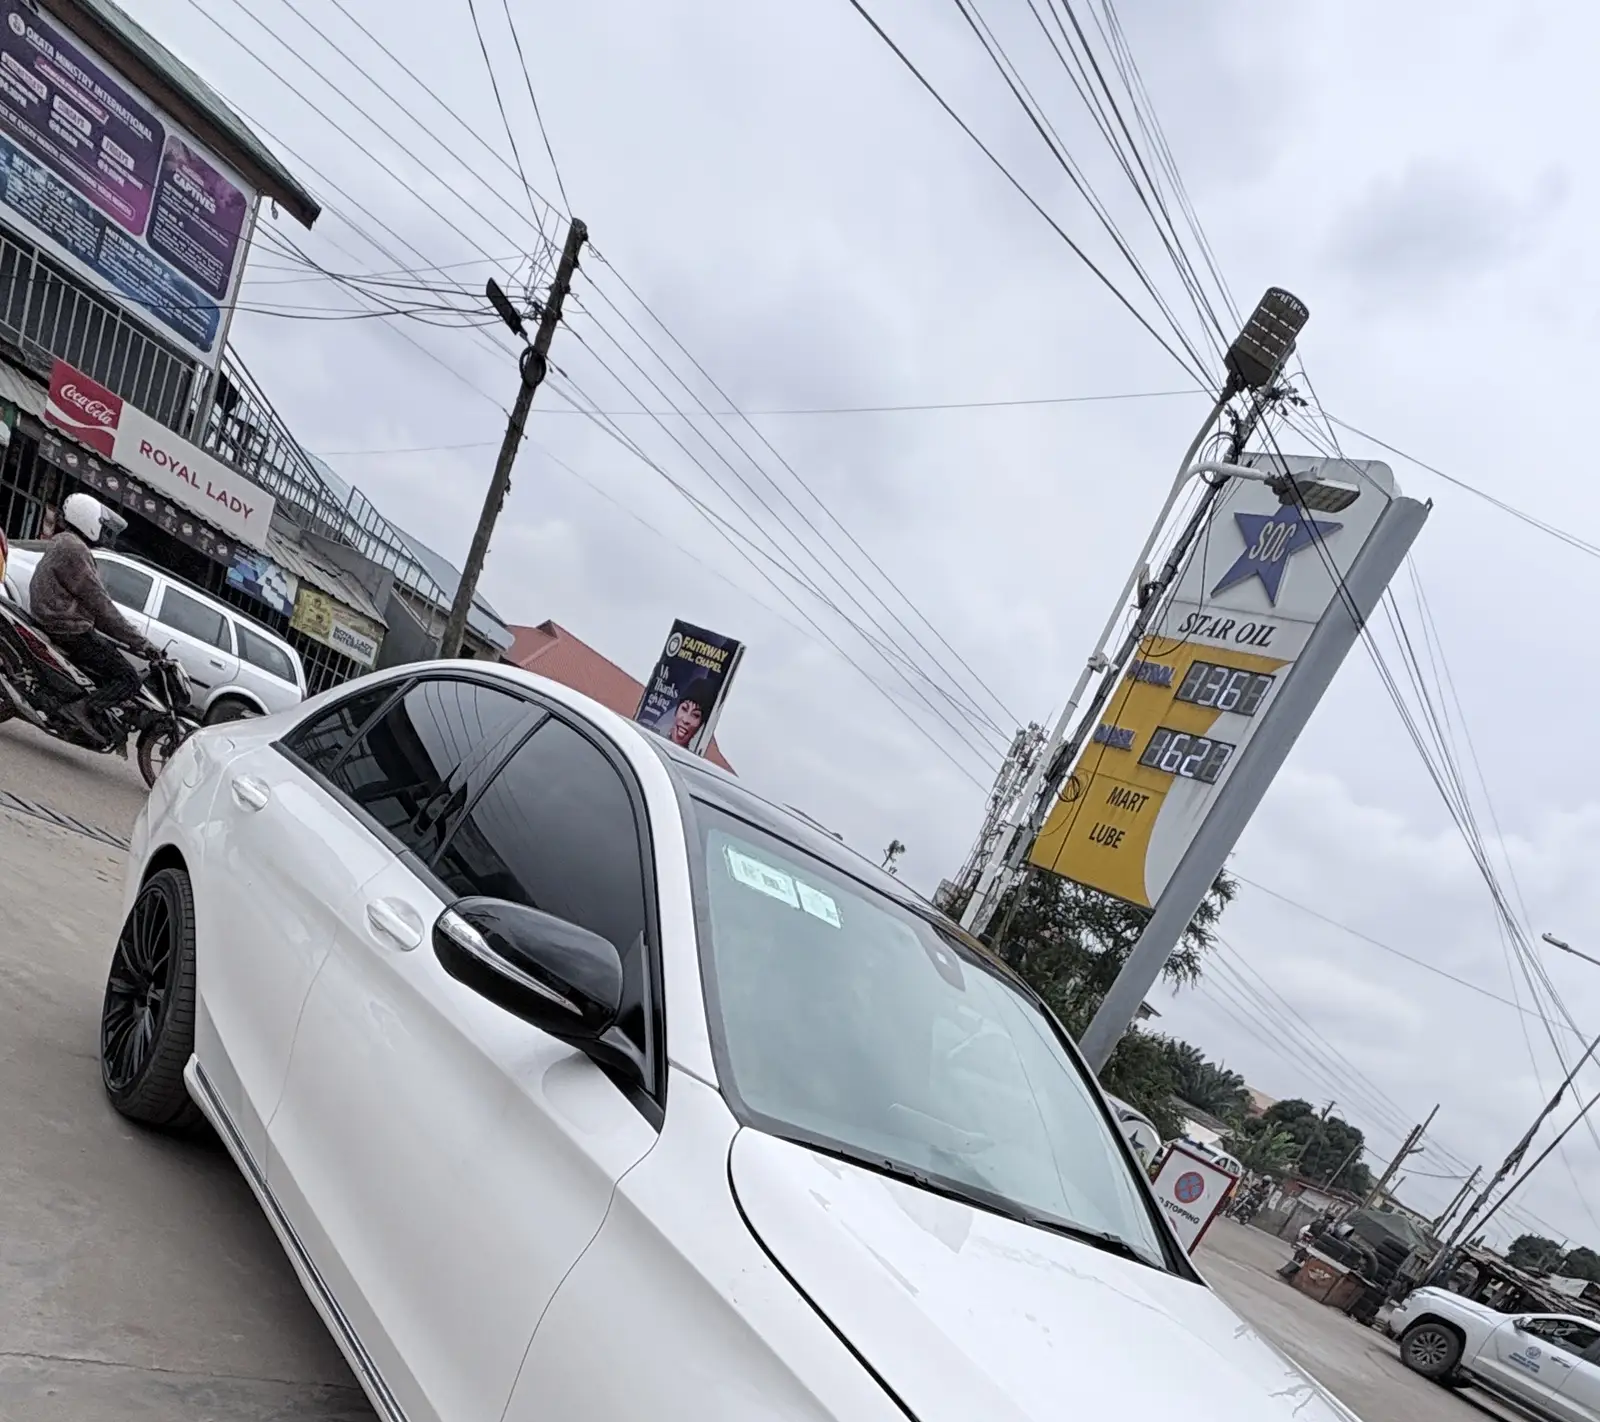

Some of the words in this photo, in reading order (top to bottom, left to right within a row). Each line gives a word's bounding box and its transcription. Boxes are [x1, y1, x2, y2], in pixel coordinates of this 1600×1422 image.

[26, 26, 54, 57] OKATA
[55, 50, 94, 89] MINISTRY
[94, 86, 153, 142] INTERNATIONAL
[172, 172, 216, 214] CAPTIVES
[140, 439, 200, 489] ROYAL
[206, 481, 254, 519] LADY
[1248, 521, 1297, 562] SOC
[1178, 612, 1236, 640] STAR
[1235, 622, 1277, 647] OIL
[682, 637, 729, 663] FAITHWAY
[695, 655, 722, 673] CHAPEL
[654, 677, 679, 698] Thanks
[1106, 786, 1150, 813] MART
[1088, 822, 1126, 849] LUBE
[1163, 1200, 1200, 1225] STOPPING
